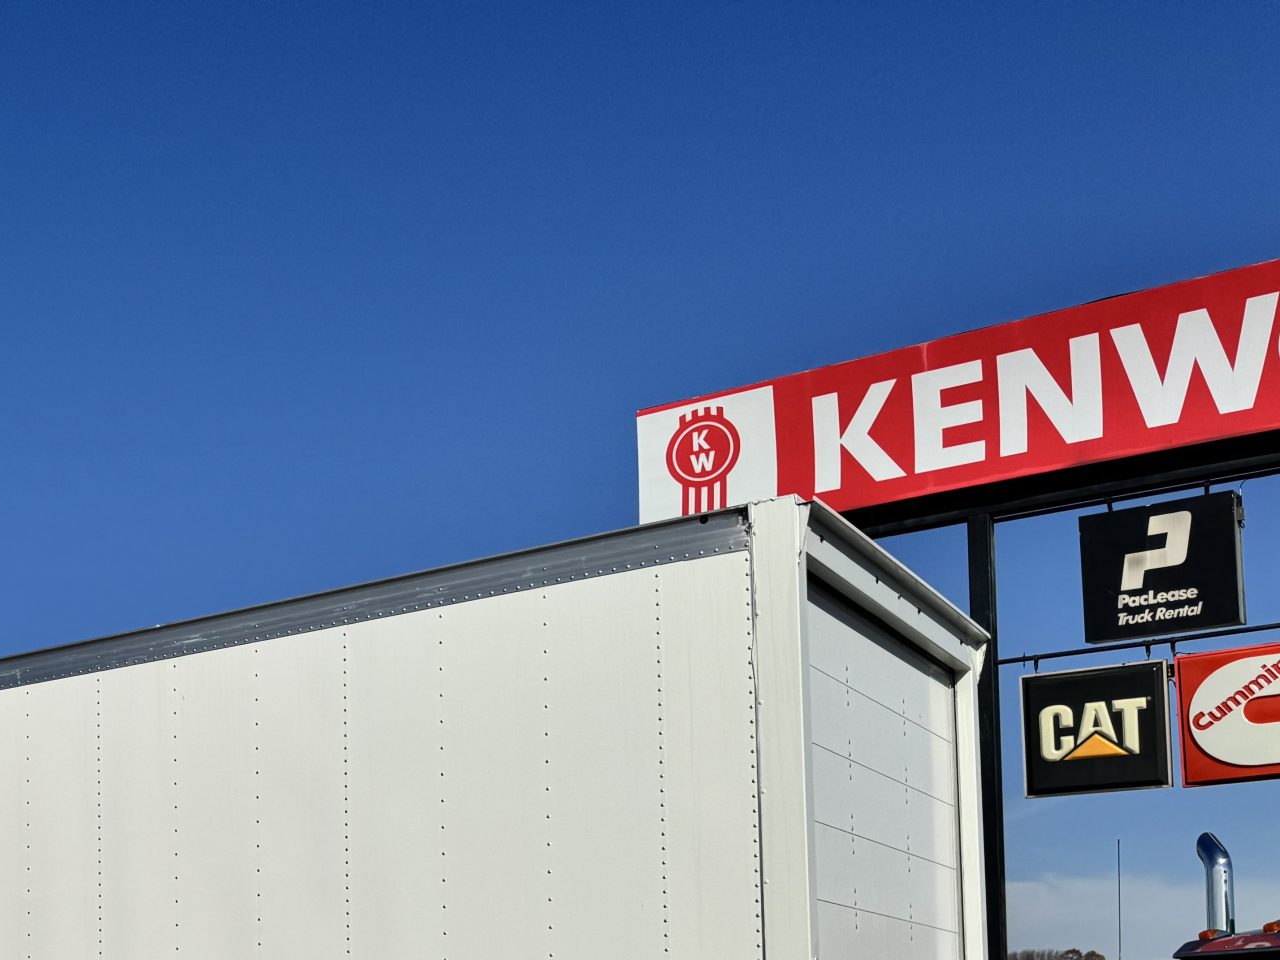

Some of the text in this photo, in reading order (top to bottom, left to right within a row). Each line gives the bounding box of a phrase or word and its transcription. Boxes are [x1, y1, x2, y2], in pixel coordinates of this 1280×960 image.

[811, 291, 1280, 494] KENW
[1117, 587, 1199, 609] PacLease
[1117, 601, 1204, 626] Truck Rental
[1038, 696, 1148, 762] CAT
